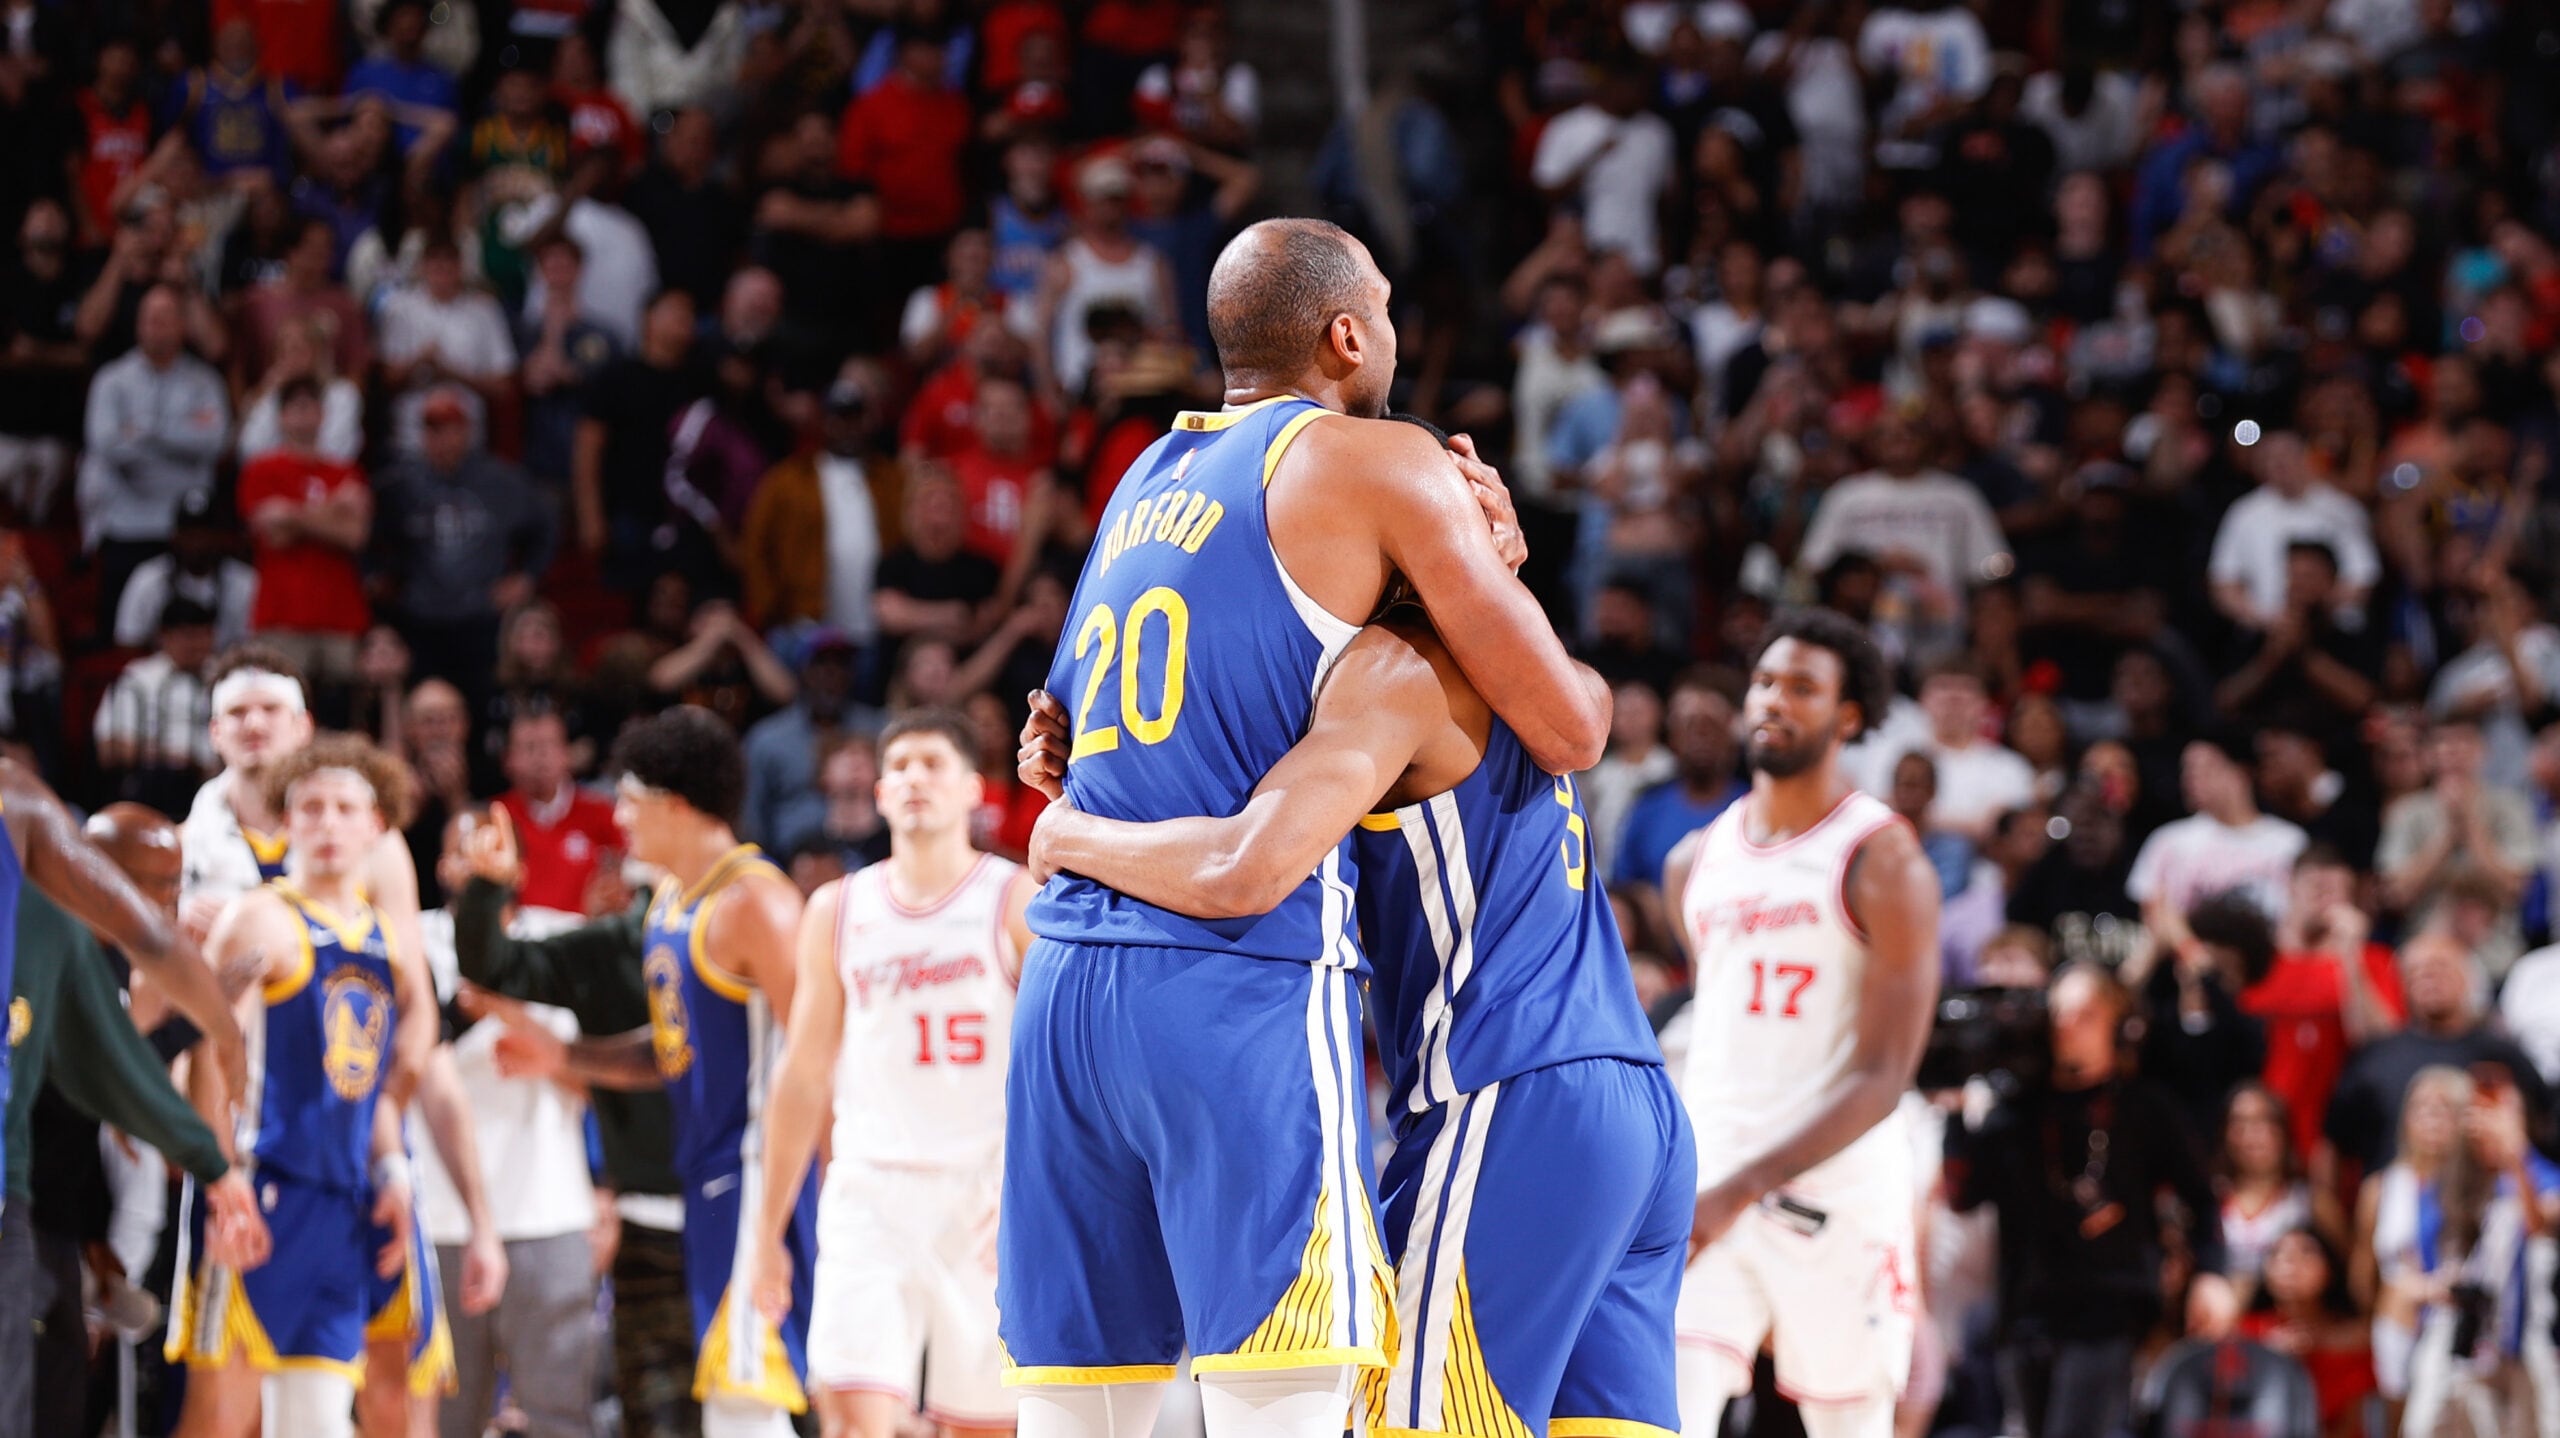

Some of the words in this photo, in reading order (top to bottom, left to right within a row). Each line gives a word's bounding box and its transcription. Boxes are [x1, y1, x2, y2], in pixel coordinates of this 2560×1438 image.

[1067, 586, 1190, 765] 20
[1748, 959, 1818, 1018] 17
[914, 1012, 987, 1065] 15
